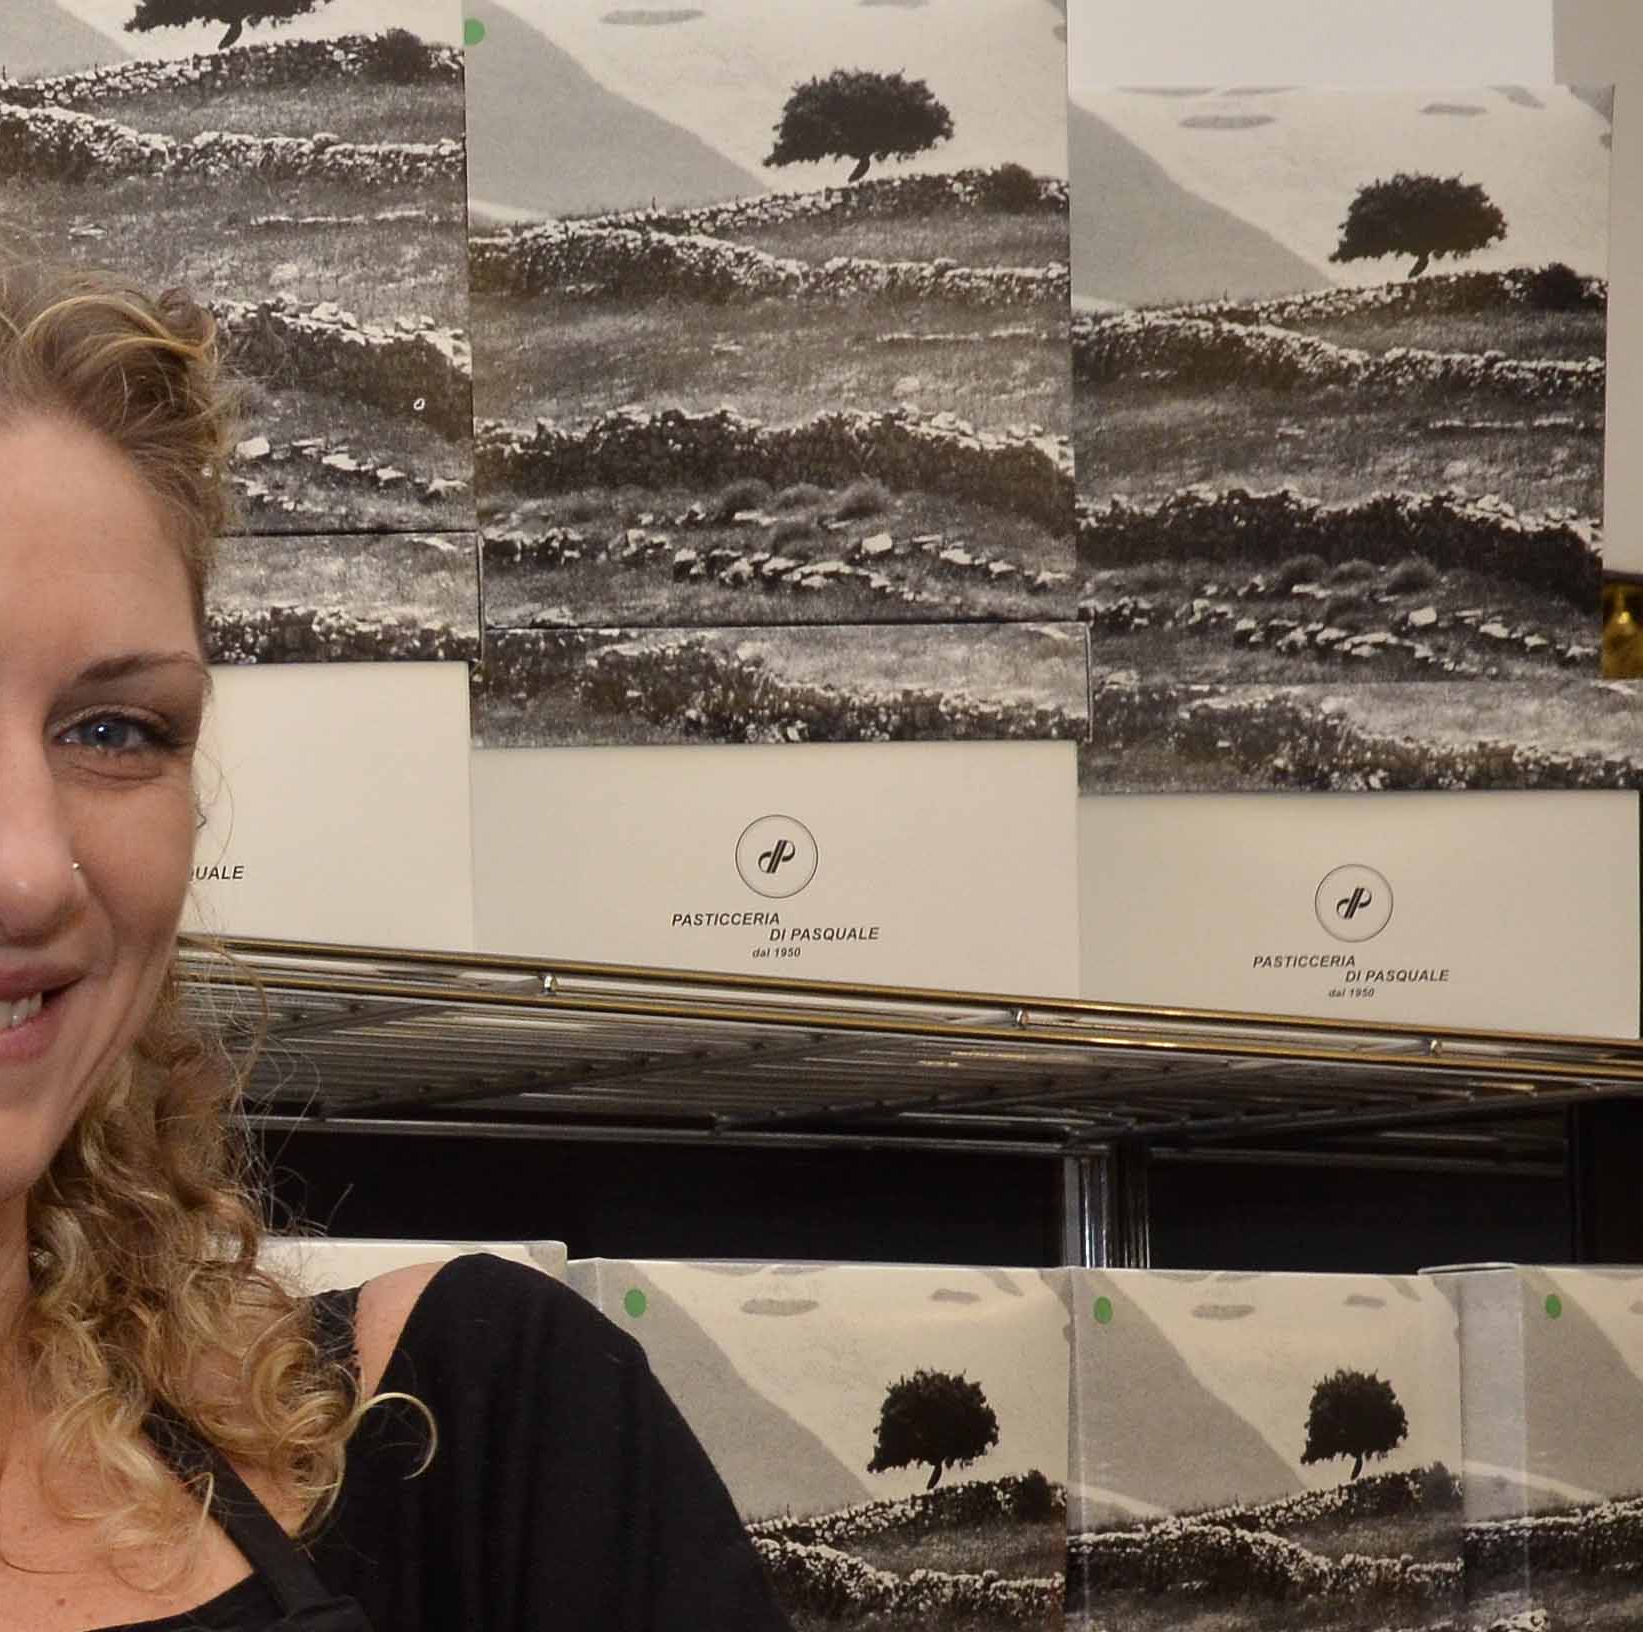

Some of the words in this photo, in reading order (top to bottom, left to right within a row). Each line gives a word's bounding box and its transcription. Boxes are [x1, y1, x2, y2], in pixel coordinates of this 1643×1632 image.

[190, 864, 245, 881] UALE
[671, 912, 780, 927] PASTICCERIA
[769, 928, 786, 942] DI
[790, 927, 880, 942] PASQUALE
[752, 947, 770, 958] dal
[774, 947, 801, 958] 1950
[1253, 955, 1356, 969] PASTICCERIA
[1345, 970, 1361, 983] DI
[1365, 969, 1450, 983] PASQUALE
[1328, 988, 1346, 998] dal
